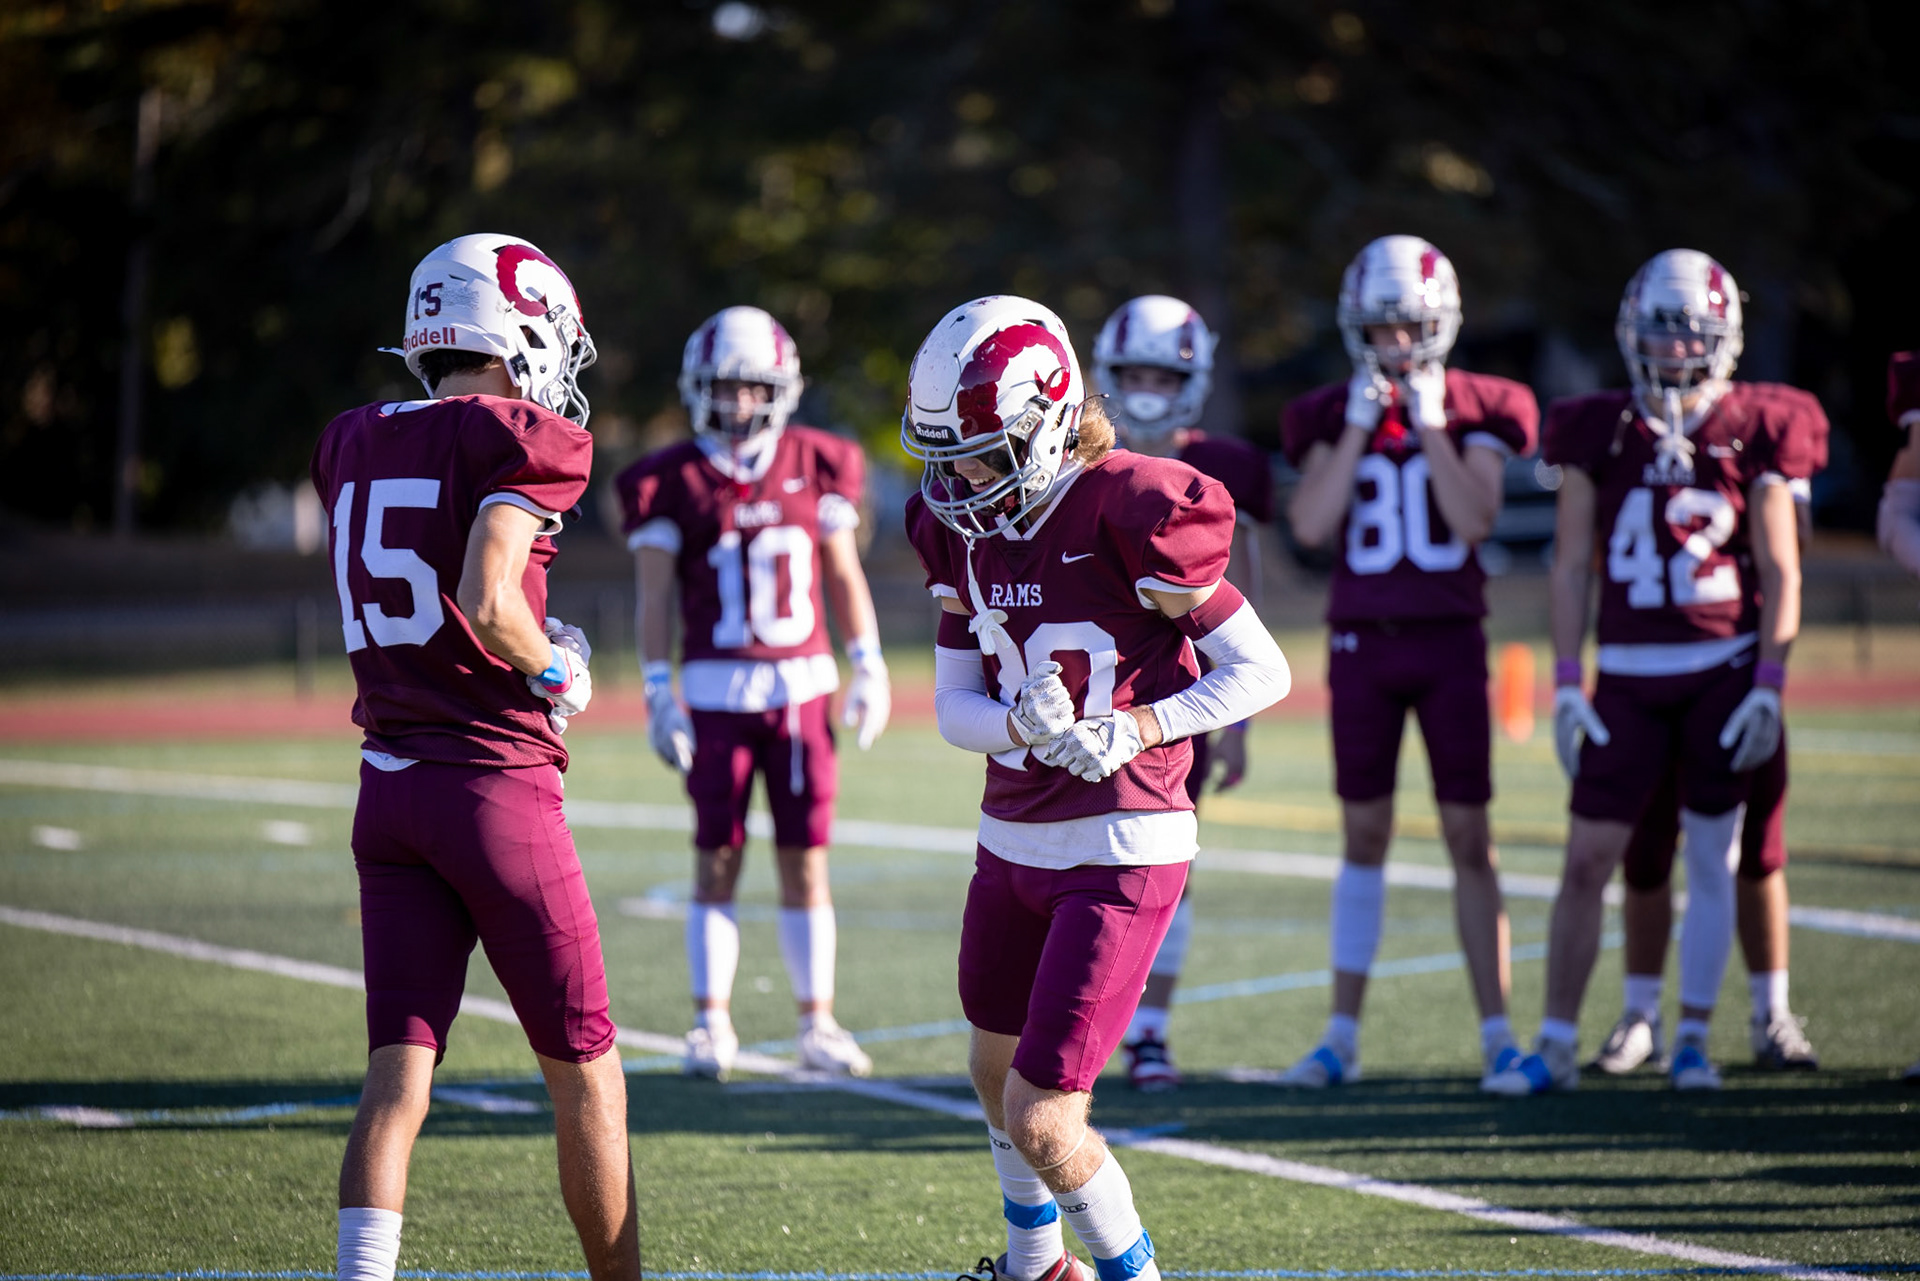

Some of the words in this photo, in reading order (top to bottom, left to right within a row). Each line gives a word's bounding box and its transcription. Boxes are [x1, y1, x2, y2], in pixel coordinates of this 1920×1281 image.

[414, 282, 443, 320] 15
[403, 327, 457, 353] Riddell
[916, 425, 949, 439] Riddell
[333, 477, 446, 654] 15
[1608, 487, 1742, 609] 42
[707, 525, 816, 649] 10
[989, 583, 1043, 607] RAMS
